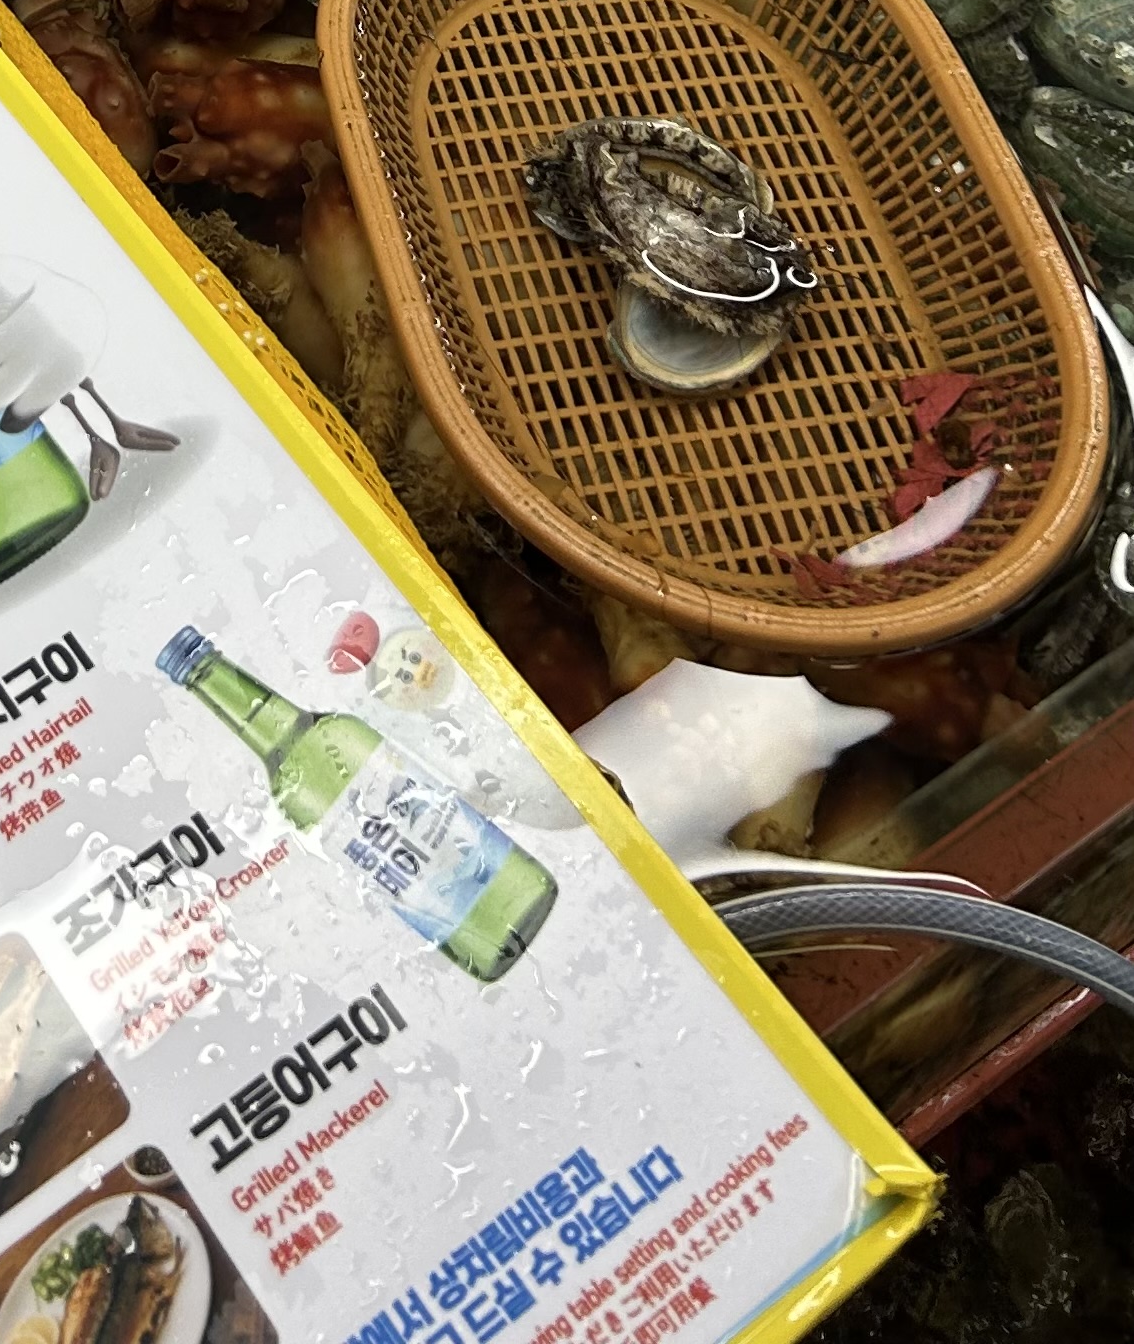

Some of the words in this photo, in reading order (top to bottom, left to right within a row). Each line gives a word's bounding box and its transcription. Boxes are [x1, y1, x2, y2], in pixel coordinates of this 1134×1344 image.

[21, 695, 94, 754] Hairtail
[52, 810, 226, 957] 조기구이
[89, 934, 155, 993] Grilled
[215, 837, 291, 900] Croaker
[188, 981, 408, 1174] 고등어구이
[231, 1149, 300, 1213] Grilled
[294, 1078, 390, 1162] Mackerel
[428, 1145, 606, 1310] 상차림비용과
[460, 1267, 537, 1344] 드실
[530, 1247, 565, 1287] 수
[558, 1144, 684, 1264] 있습니다
[566, 1276, 615, 1321] table
[614, 1227, 677, 1286] setting
[671, 1193, 708, 1236] and
[706, 1144, 776, 1206] cooking
[765, 1113, 809, 1151] fees
